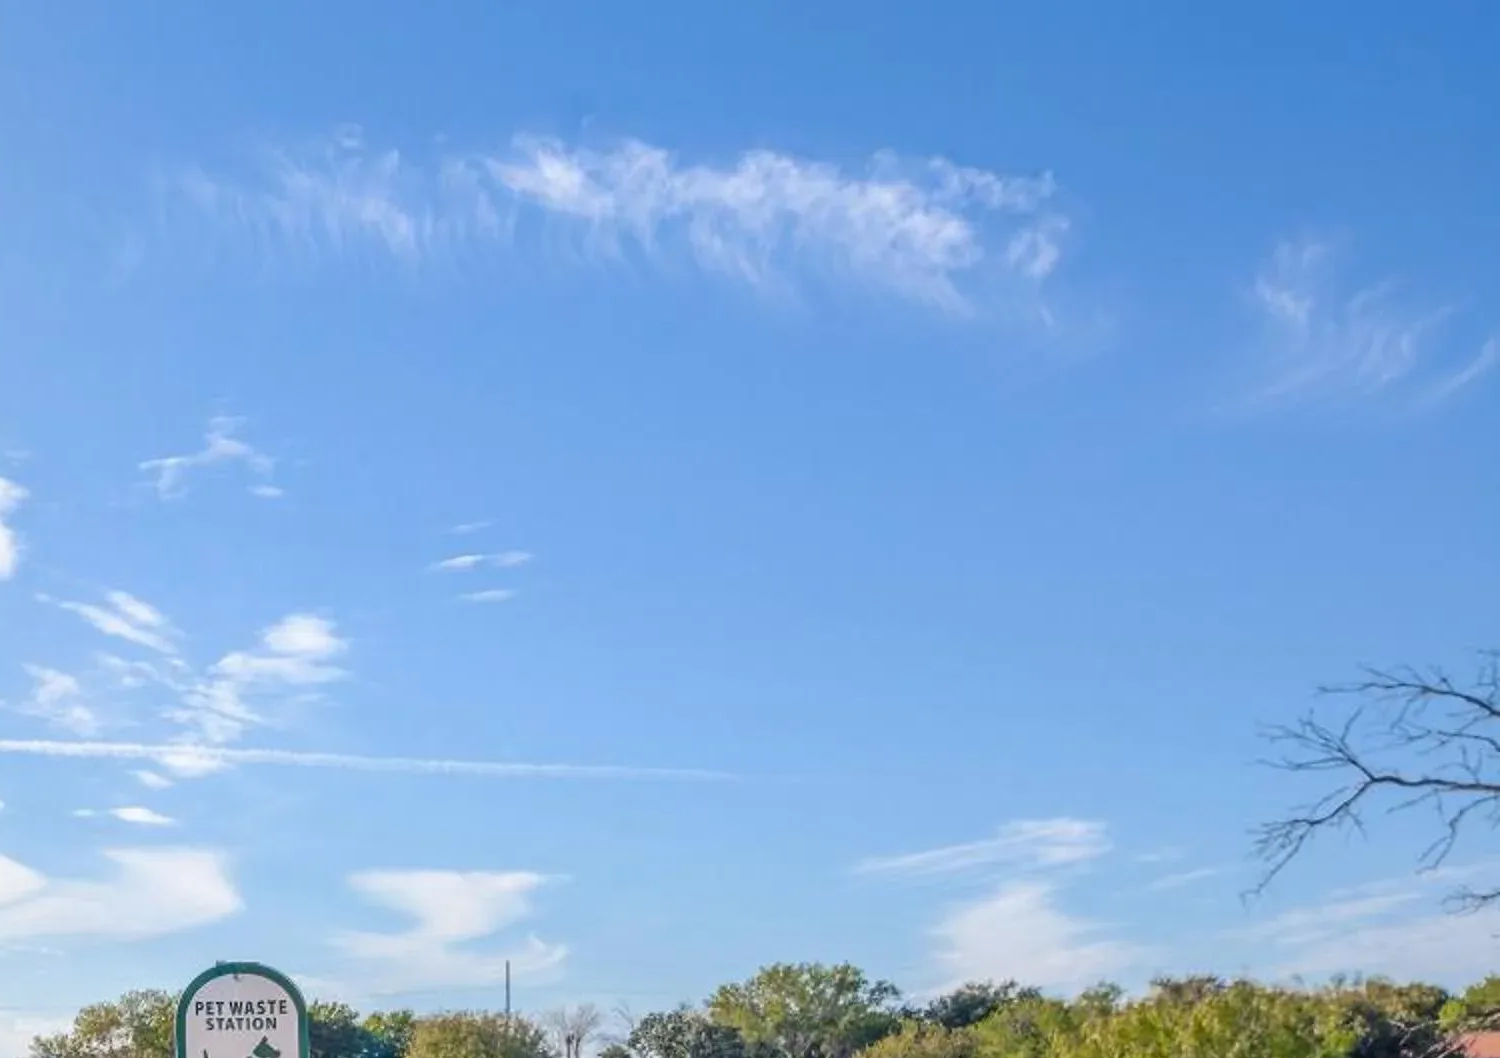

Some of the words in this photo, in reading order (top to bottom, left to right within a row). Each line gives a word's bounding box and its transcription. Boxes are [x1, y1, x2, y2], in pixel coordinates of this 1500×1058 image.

[195, 1001, 225, 1016] PET
[229, 999, 288, 1015] WASTE
[205, 1017, 277, 1031] STATION
